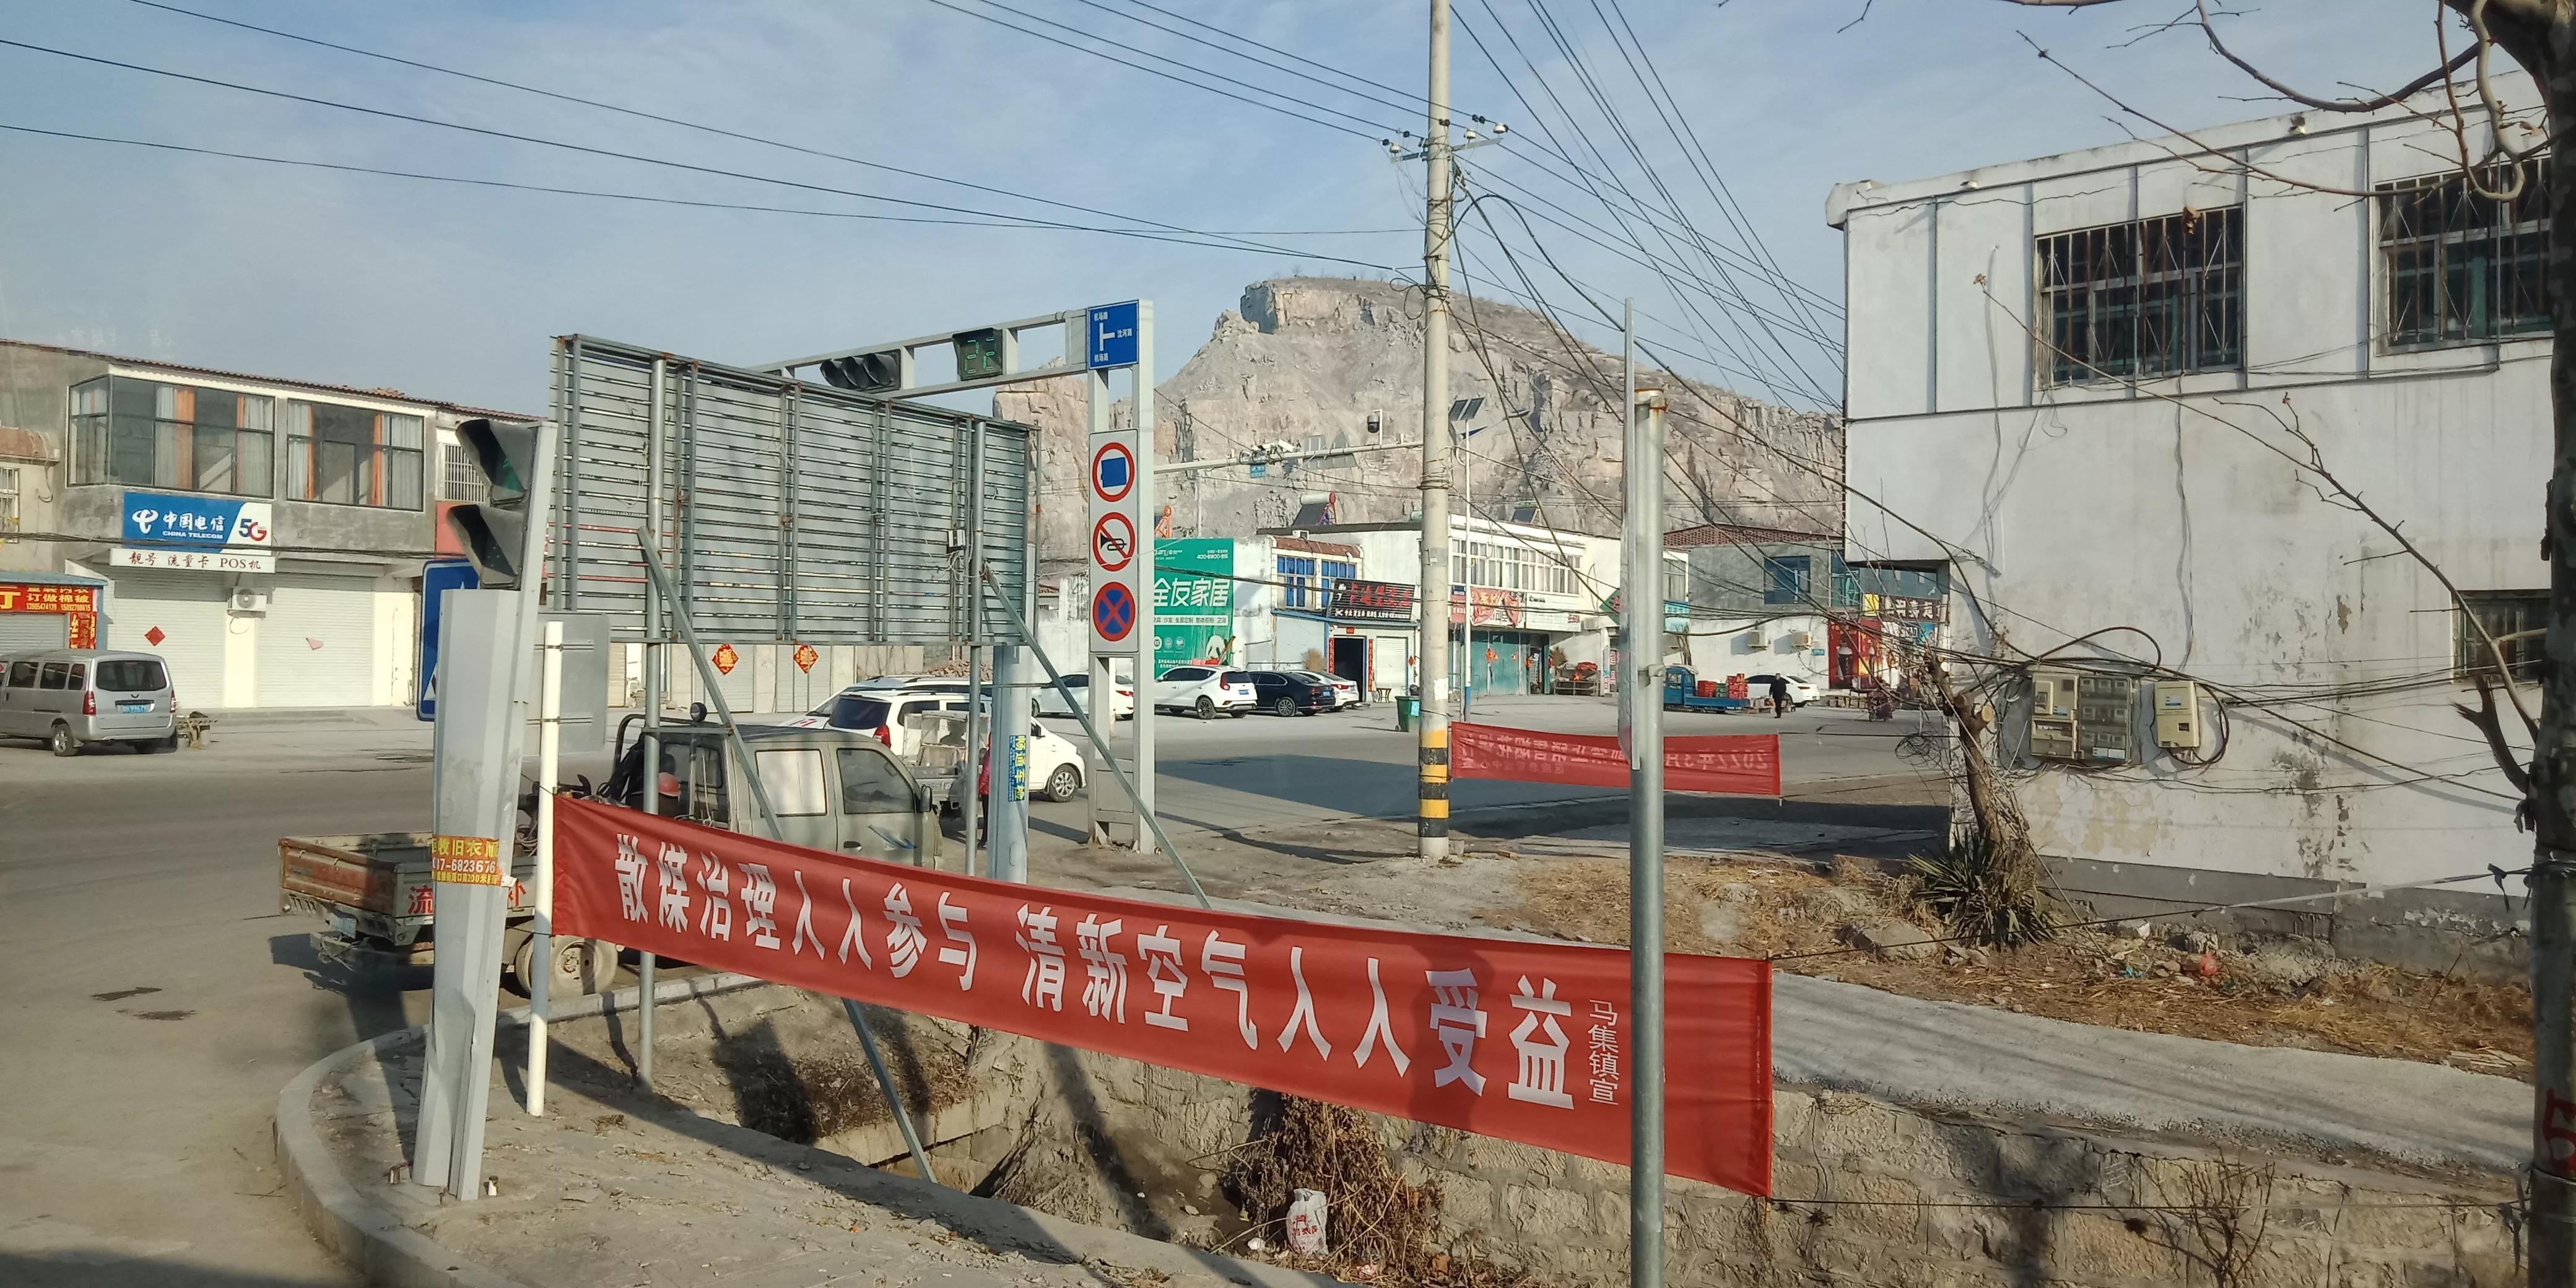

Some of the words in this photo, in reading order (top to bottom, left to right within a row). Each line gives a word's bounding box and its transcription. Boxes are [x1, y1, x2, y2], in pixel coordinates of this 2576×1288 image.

[163, 510, 225, 531] 中国电信
[238, 518, 267, 541] 5G
[129, 551, 156, 565] 靓号
[168, 555, 209, 568] 流量卡
[220, 558, 261, 569] POS机
[27, 593, 89, 603] 订做棉被
[1154, 577, 1230, 606] 全友家居
[614, 833, 978, 991] 散煤治理人人参与
[1015, 903, 1574, 1109] 清新空气人人受益
[1588, 999, 1619, 1105] 马集镇宣
